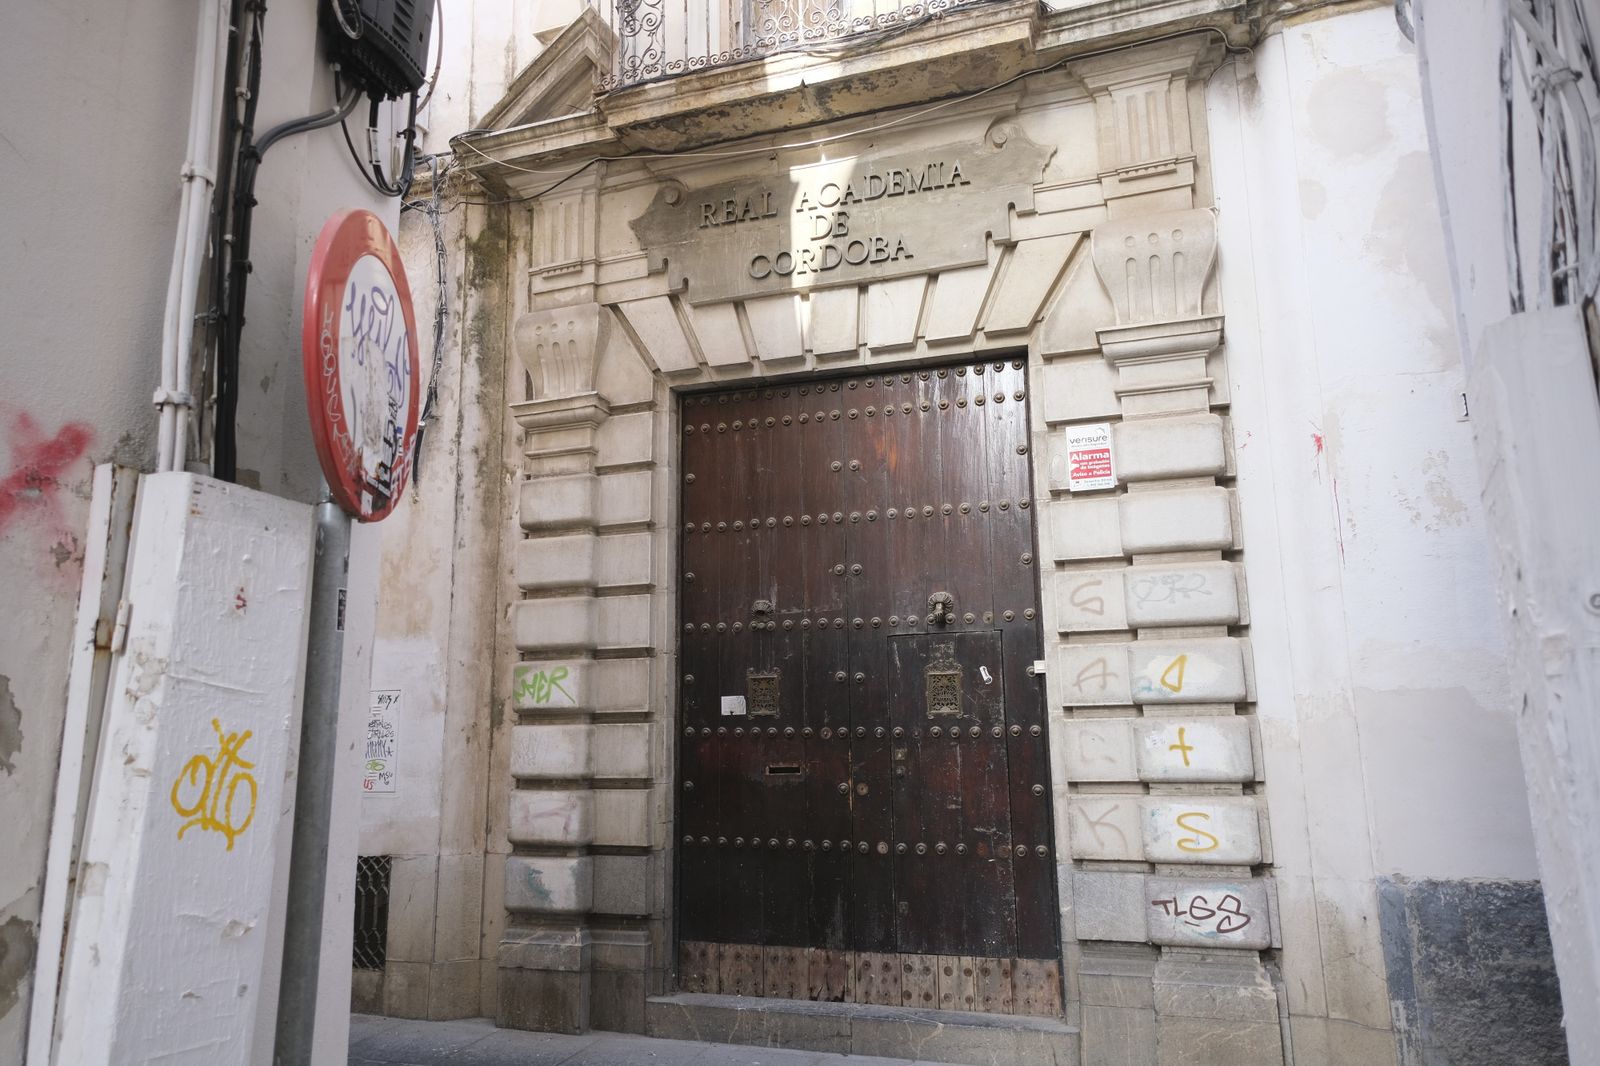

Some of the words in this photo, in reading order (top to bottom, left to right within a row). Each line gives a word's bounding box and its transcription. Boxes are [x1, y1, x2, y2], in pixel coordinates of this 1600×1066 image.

[700, 191, 778, 229] REAL
[796, 159, 971, 213] ACADEMIA
[809, 211, 849, 242] DE
[750, 236, 914, 279] CORDOBA
[1070, 435, 1107, 444] verisure
[1071, 452, 1110, 461] Alarma
